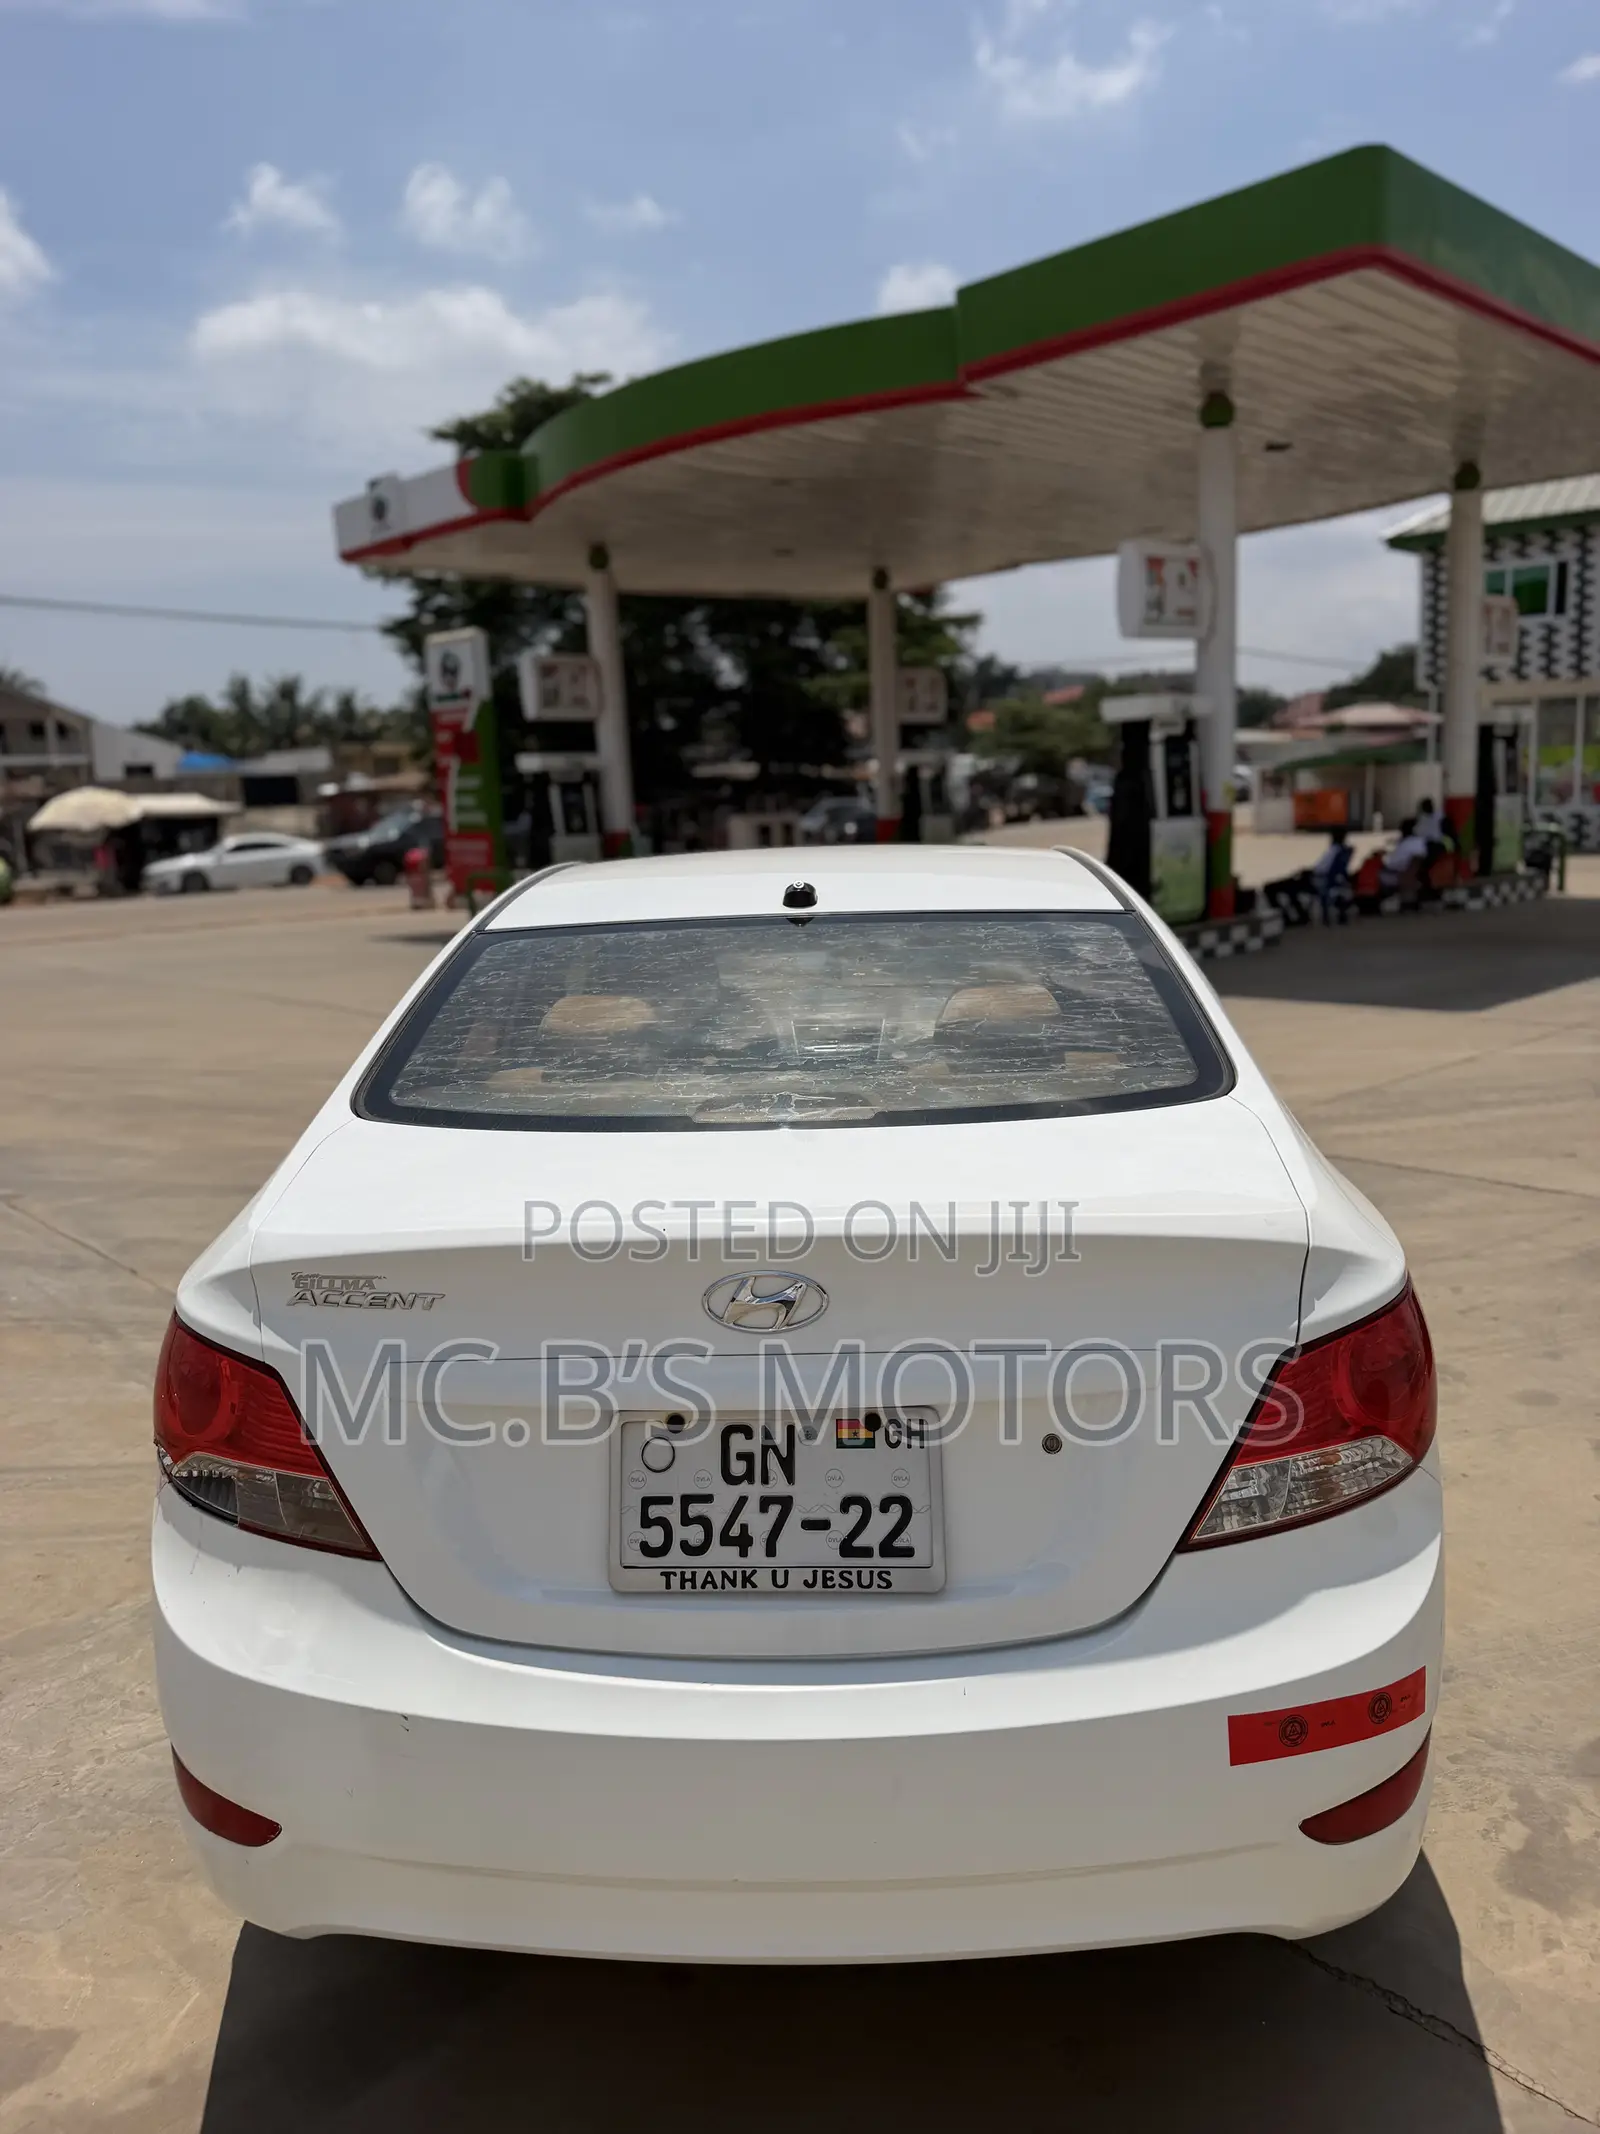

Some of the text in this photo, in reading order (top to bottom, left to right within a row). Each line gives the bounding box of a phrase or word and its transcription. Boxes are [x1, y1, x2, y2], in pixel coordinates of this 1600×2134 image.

[286, 1289, 446, 1311] ACCENT
[884, 1418, 925, 1450] GH
[720, 1424, 795, 1486] GN
[639, 1494, 915, 1558] 5547-22
[660, 1569, 893, 1590] THANK U JESUS
